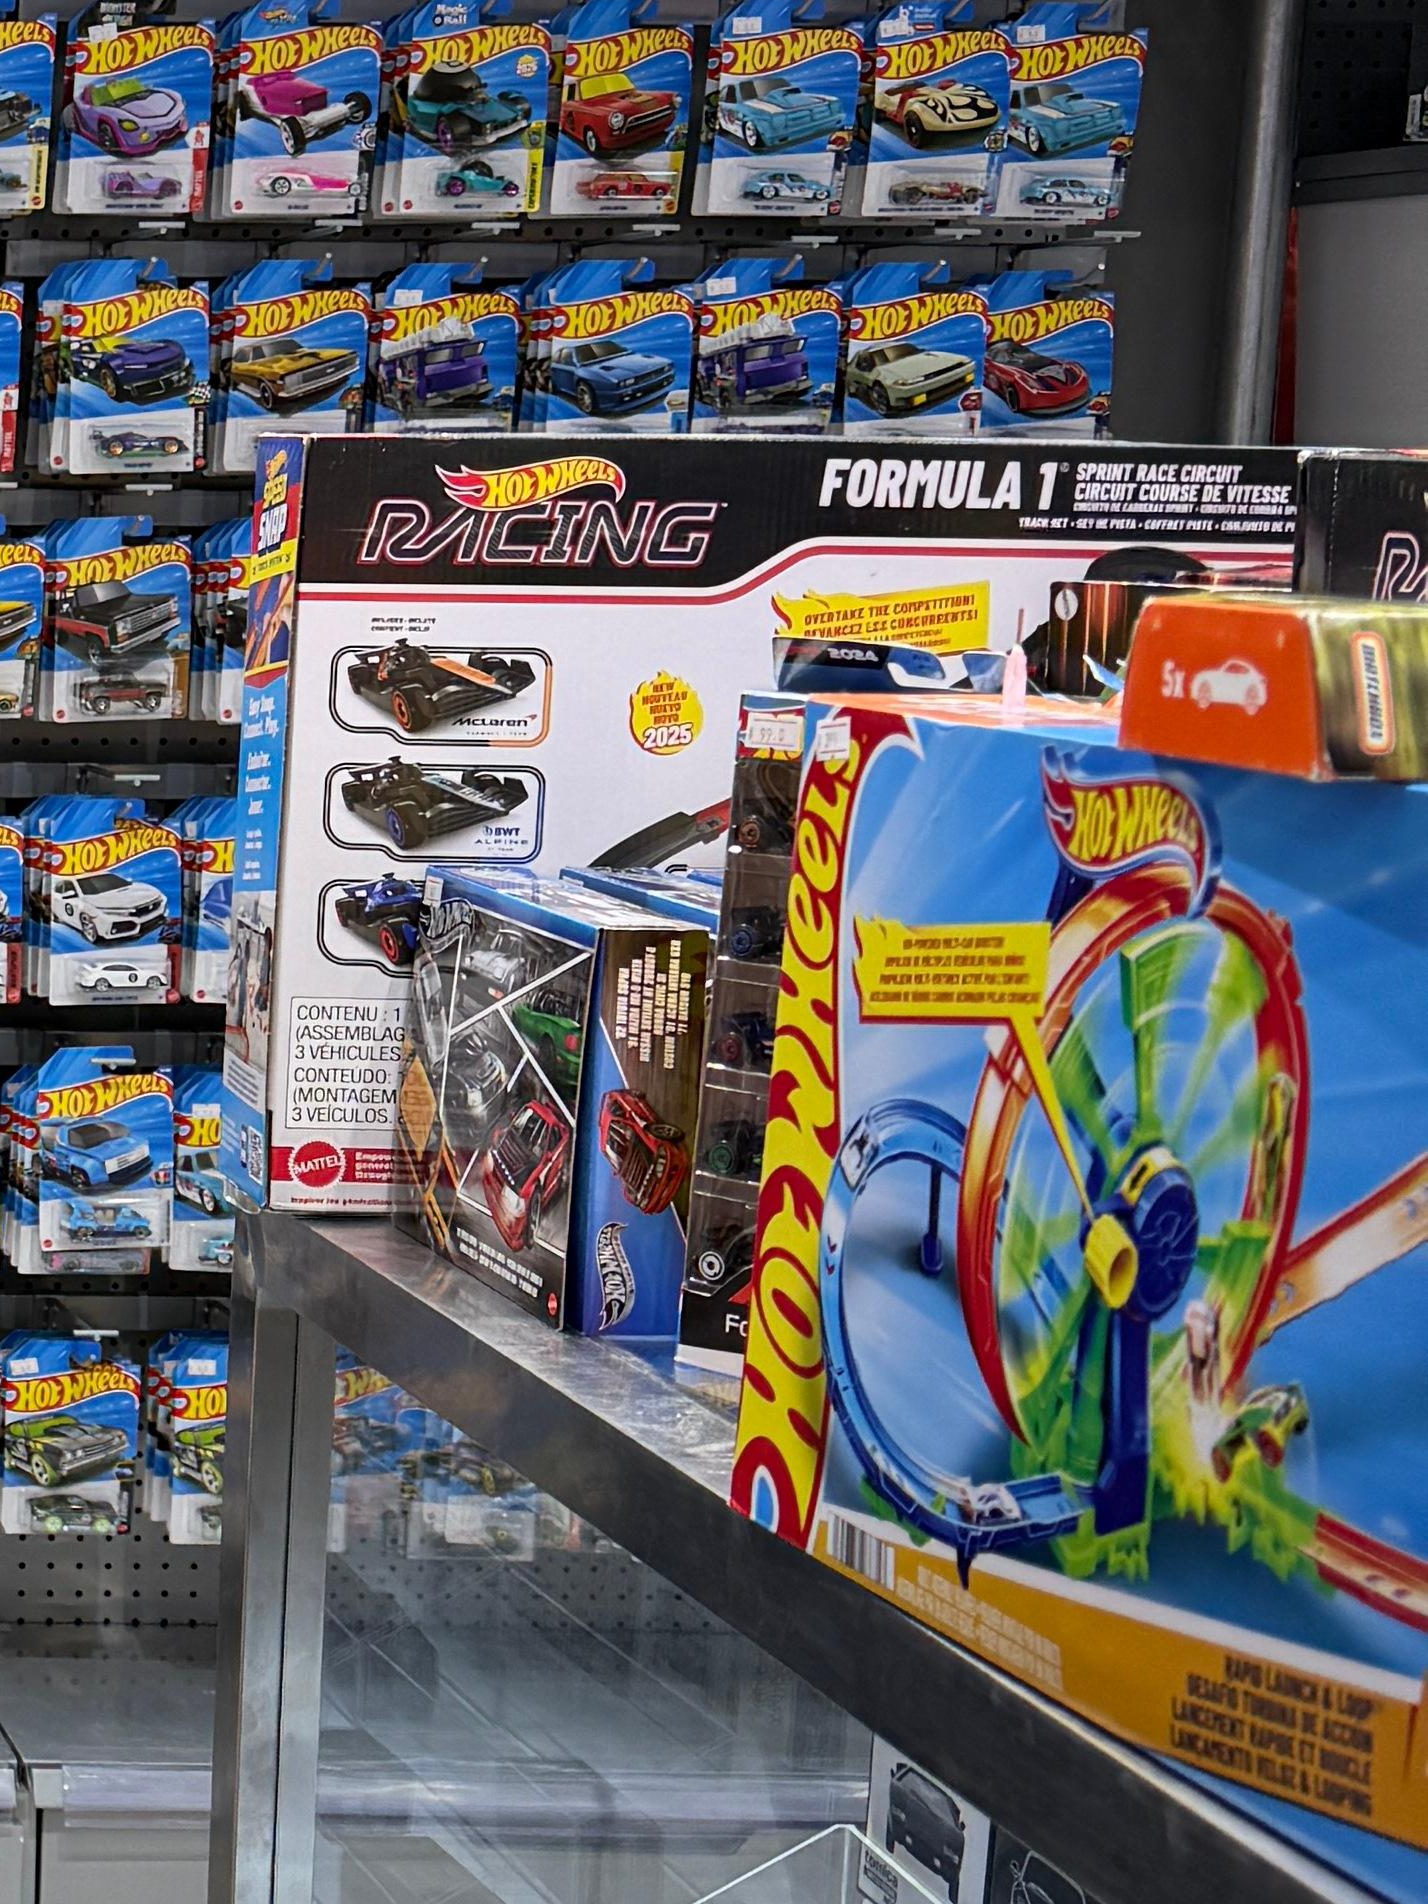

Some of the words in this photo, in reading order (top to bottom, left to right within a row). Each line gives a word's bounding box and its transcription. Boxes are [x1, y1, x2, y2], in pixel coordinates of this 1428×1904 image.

[250, 33, 308, 75] HOT
[305, 27, 375, 64] WHEELS
[732, 35, 789, 74] HOT
[787, 30, 856, 65] WHEELS
[1017, 41, 1075, 80] HOT
[1072, 36, 1139, 69] WHEELS
[564, 298, 621, 339] HOT
[619, 293, 686, 326] WHEELS
[485, 472, 536, 509] HOT
[526, 460, 615, 495] WHEELS
[818, 458, 1022, 510] FORMULA
[1038, 459, 1058, 510] 1
[1075, 462, 1140, 483] SPRINT
[1143, 463, 1179, 483] RACE
[1180, 464, 1243, 484] CIRCUIT
[1074, 483, 1136, 501] CIRCUIT
[1139, 484, 1200, 503] COURSE
[1204, 485, 1223, 503] DE
[1226, 485, 1293, 504] VITESSE
[356, 498, 720, 570] RACING
[1161, 659, 1185, 699] 5x
[451, 715, 529, 729] McLaren
[642, 724, 693, 749] 2025
[494, 825, 521, 837] BWT
[1070, 789, 1123, 863] HOT
[1114, 784, 1200, 854] WHEELS
[296, 1004, 378, 1021] CONTENU
[295, 1024, 406, 1043] (ASSEMBLAG
[294, 1045, 306, 1060] 3
[293, 1064, 392, 1085] CONTEÚDO:
[291, 1107, 302, 1122] 3
[305, 1104, 393, 1124] VEÍCULOS.
[294, 1154, 340, 1175] MATTEL
